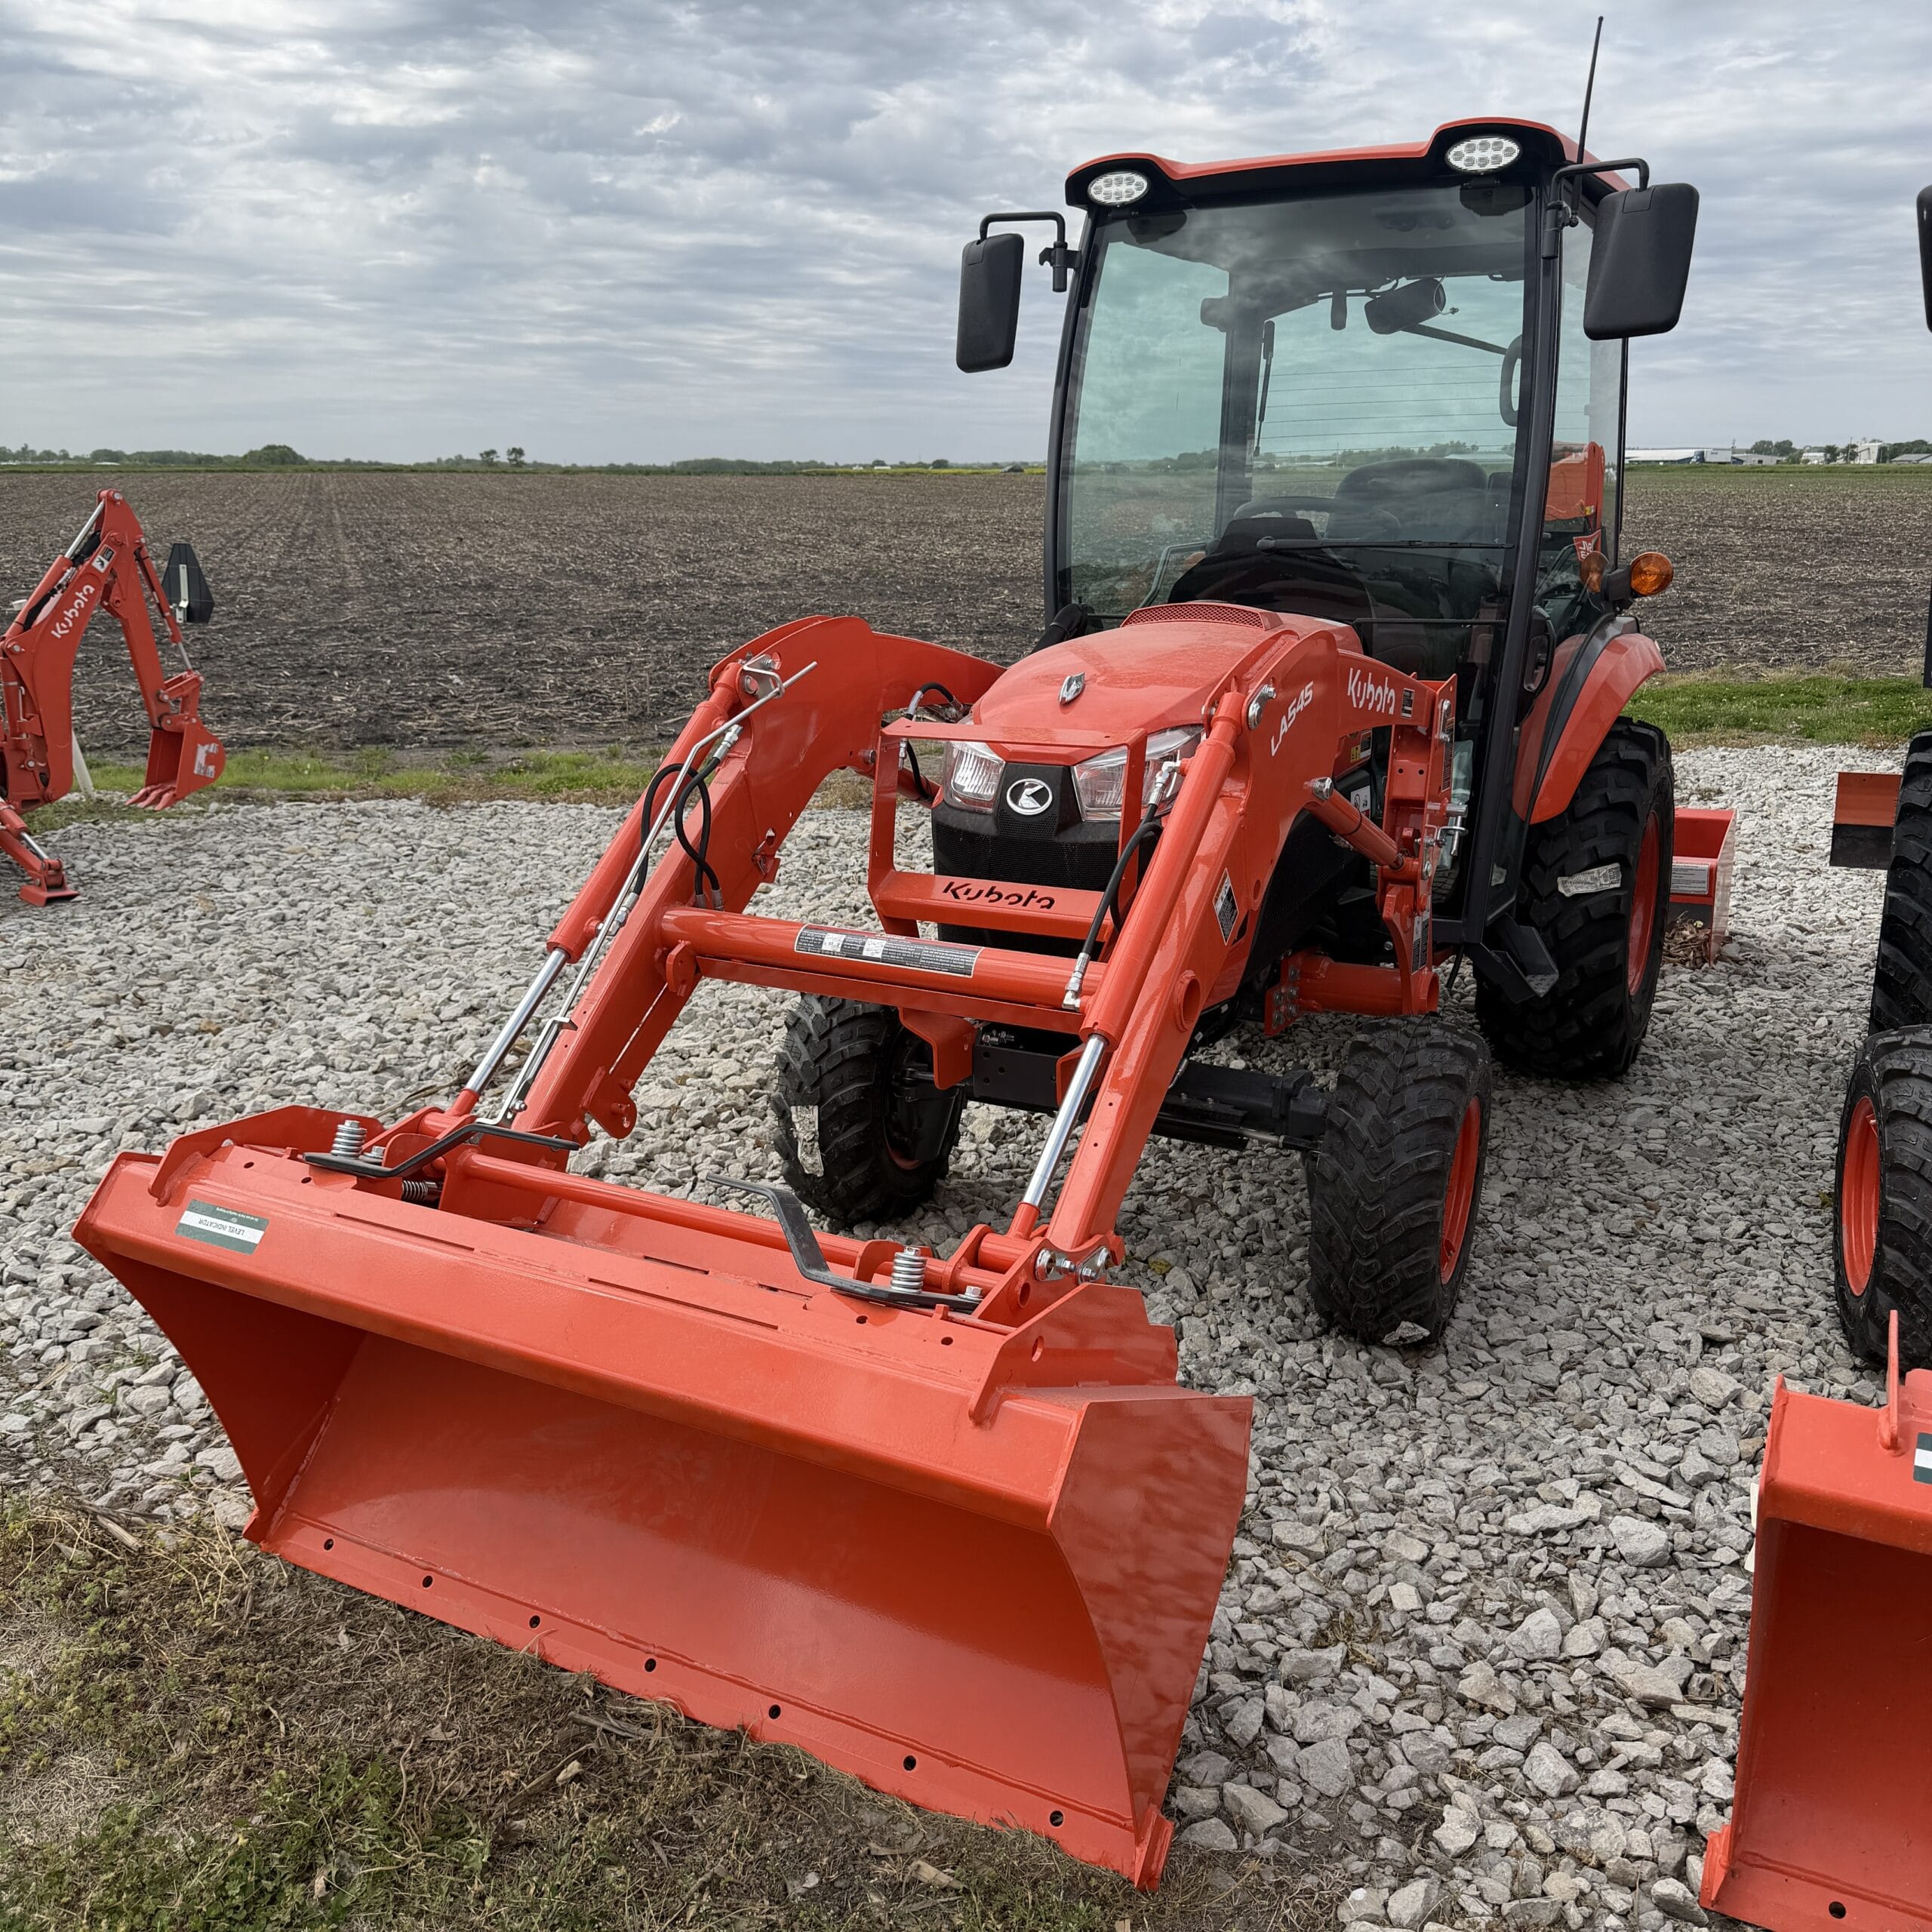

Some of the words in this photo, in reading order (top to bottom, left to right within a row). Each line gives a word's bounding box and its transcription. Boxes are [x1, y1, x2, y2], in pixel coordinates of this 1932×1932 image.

[51, 584, 95, 638] Kubota
[1347, 667, 1395, 715] Kubota
[1271, 681, 1313, 757] LA545
[942, 881, 1056, 909] Kubota
[198, 1218, 227, 1231] INDICATOR
[228, 1226, 245, 1235] LEVEL
